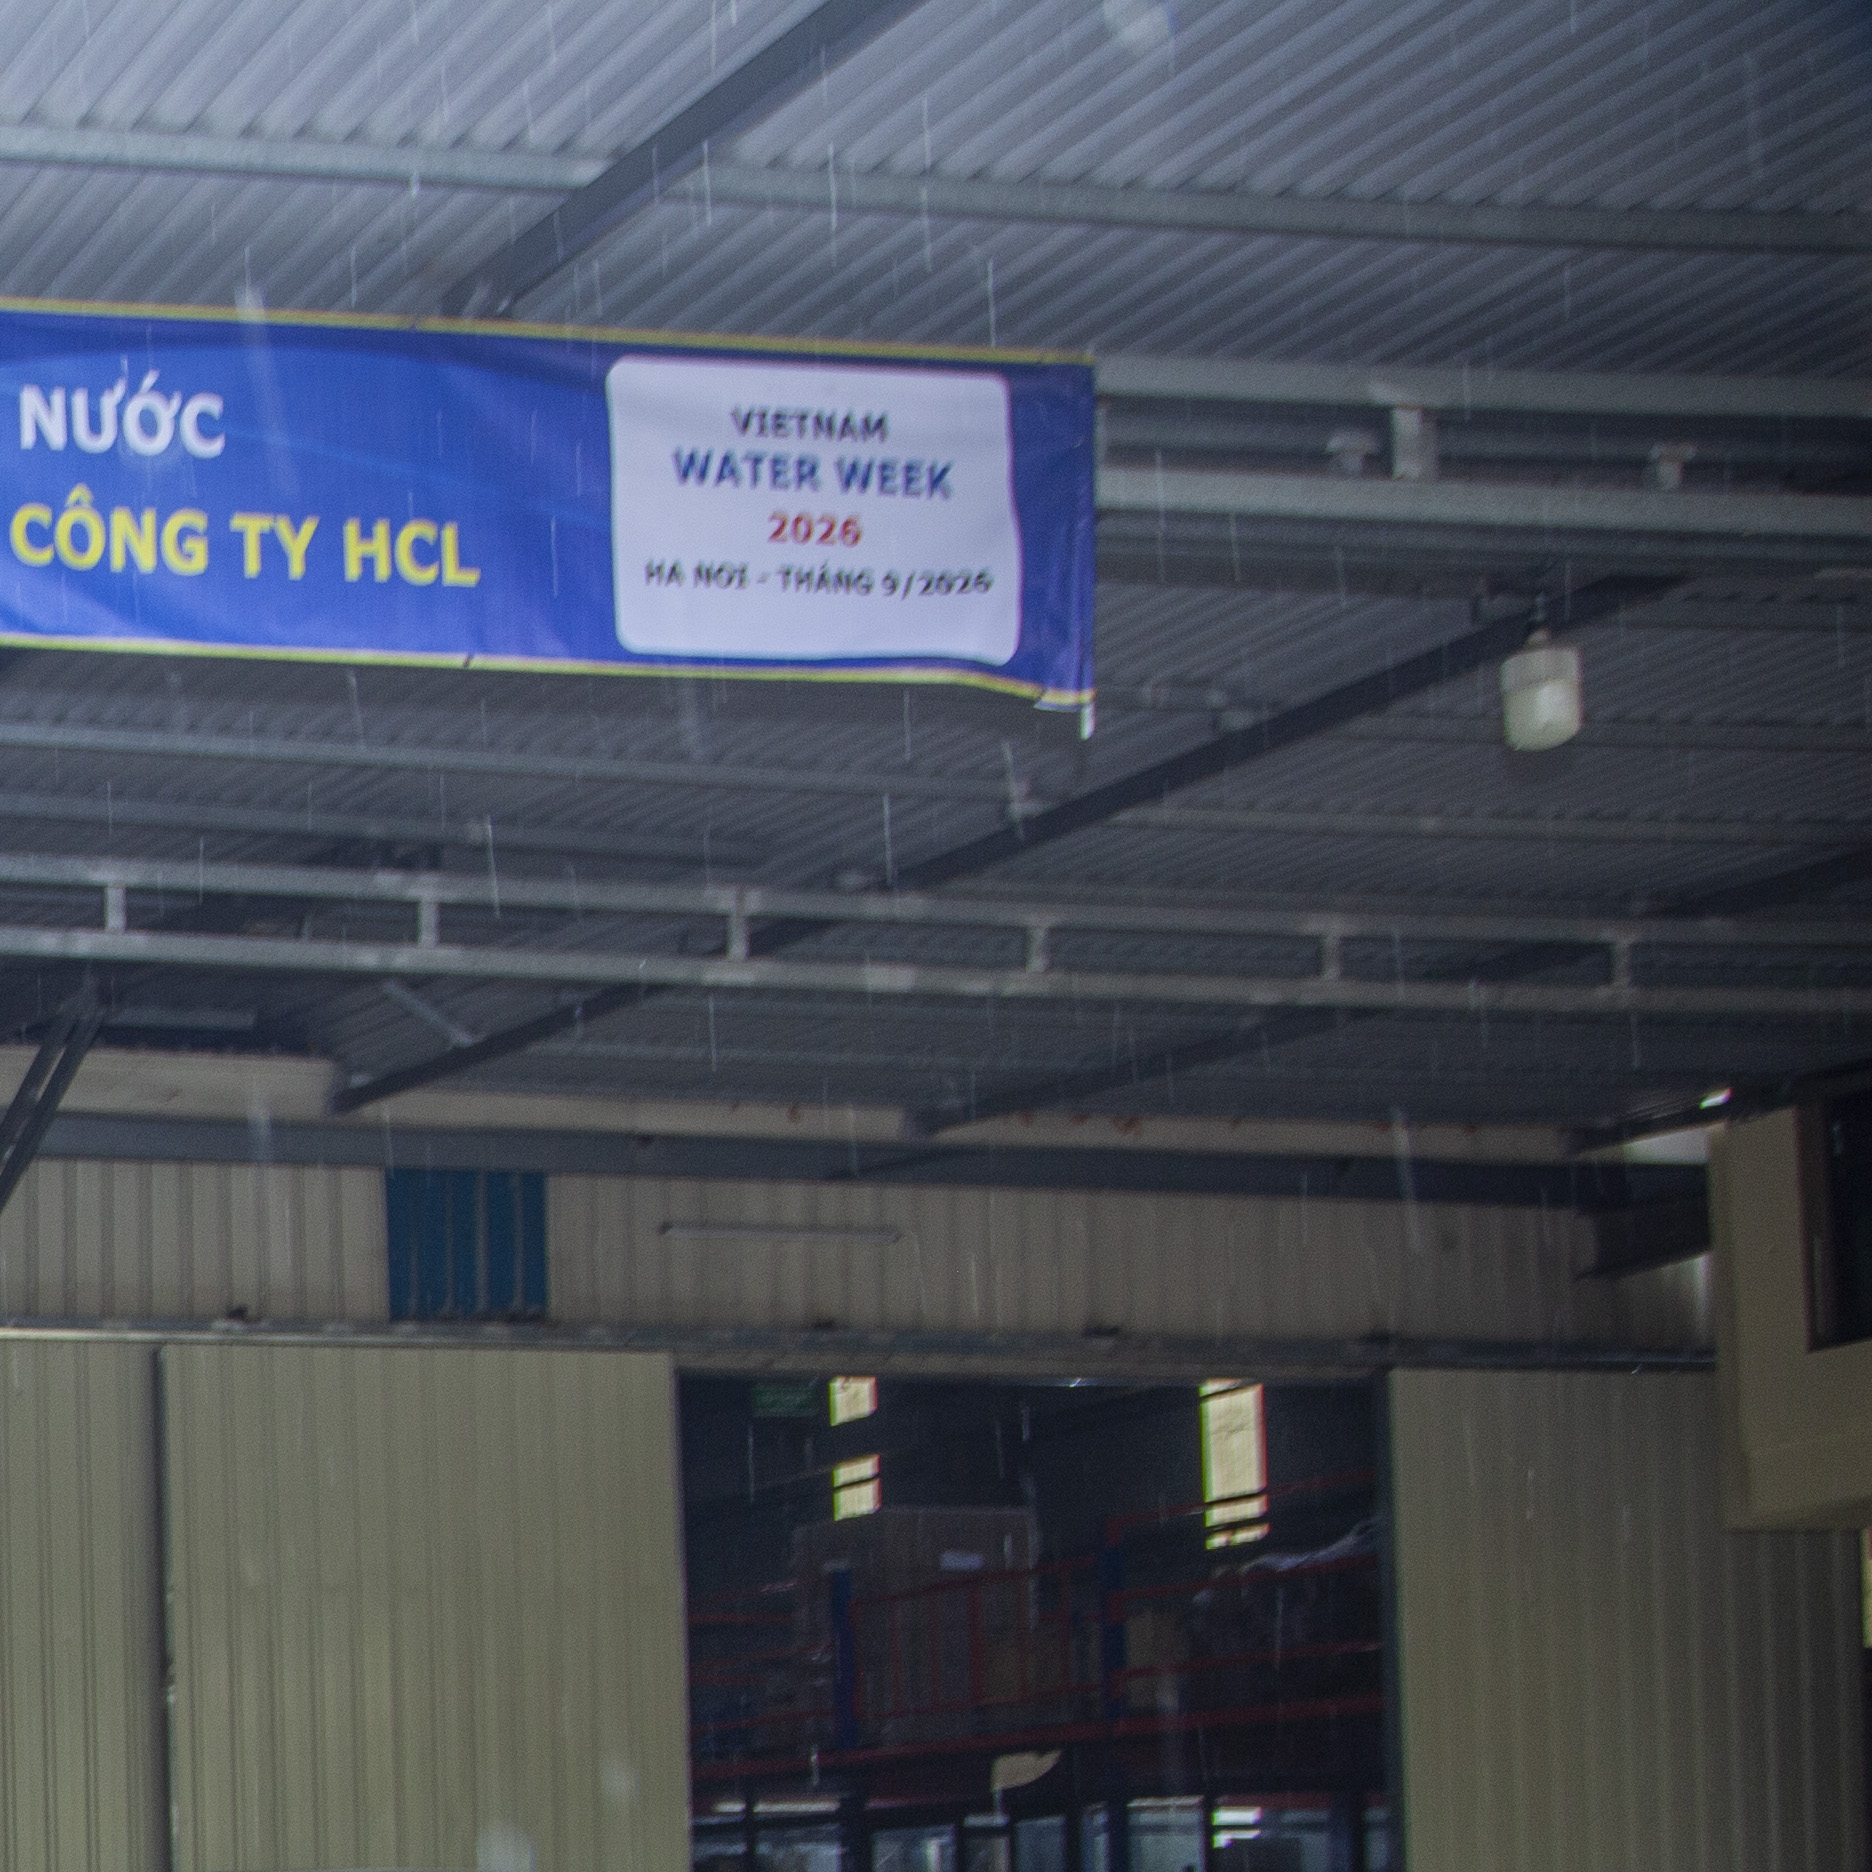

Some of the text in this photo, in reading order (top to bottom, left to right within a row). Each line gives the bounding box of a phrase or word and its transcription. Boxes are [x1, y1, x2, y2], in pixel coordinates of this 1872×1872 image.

[19, 371, 227, 458] NƯỚC
[730, 404, 891, 443] VIETNAM
[672, 445, 955, 500] WATER WEEK
[10, 484, 209, 576] CÔNG
[230, 513, 320, 581] TY
[343, 517, 482, 589] HCL
[767, 512, 863, 548] 2026
[778, 562, 873, 595] THÁNG
